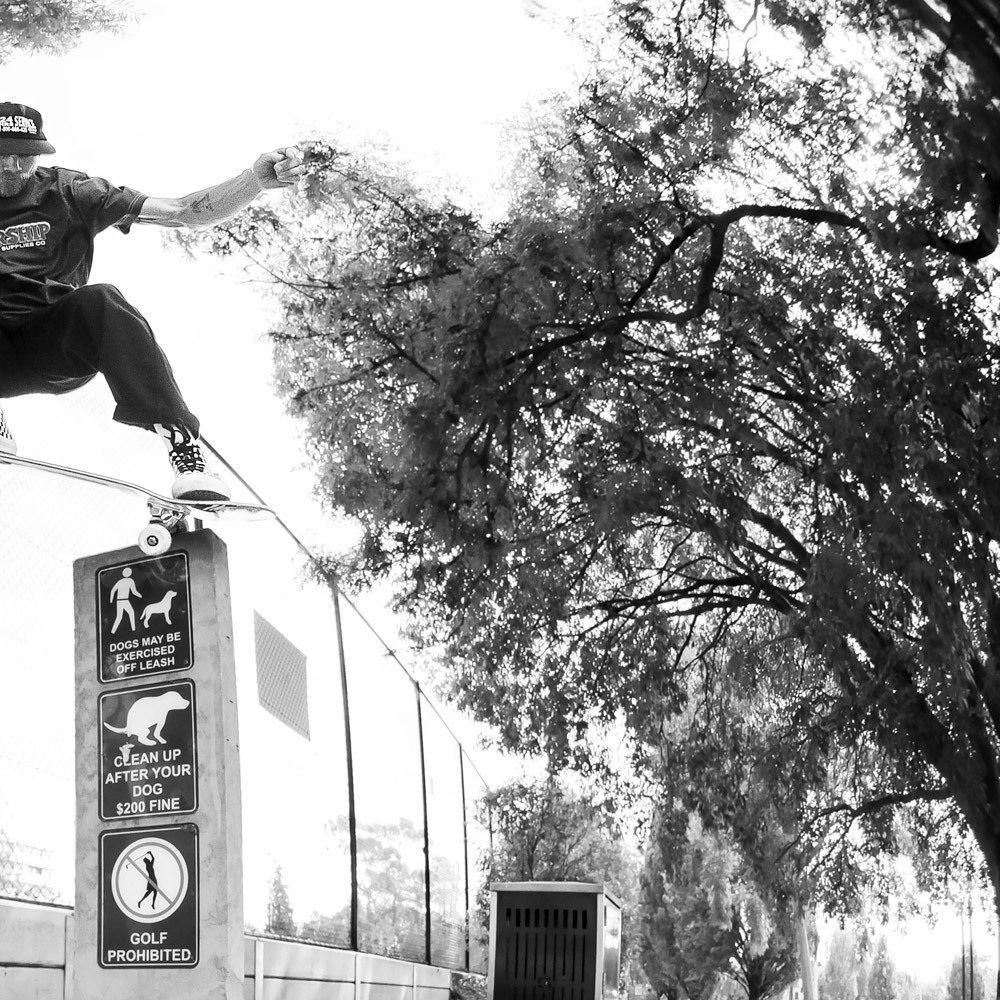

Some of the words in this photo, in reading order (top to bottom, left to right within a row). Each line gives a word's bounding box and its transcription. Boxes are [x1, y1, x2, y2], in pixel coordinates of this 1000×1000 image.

[1, 242, 34, 251] SUPPLIES
[109, 639, 139, 652] DOGS
[141, 634, 164, 646] MAY
[166, 632, 181, 642] BE
[116, 645, 175, 662] EXERCISED
[116, 662, 137, 674] OFF
[139, 657, 175, 670] LEASH
[114, 751, 158, 767] CLEAN
[163, 749, 181, 761] UP
[105, 769, 149, 784] AFTER
[152, 764, 191, 779] YOUR
[132, 783, 163, 797] DOG
[116, 801, 145, 815] $200
[149, 797, 180, 812] FINE
[130, 931, 168, 945] GOLF
[107, 949, 191, 962] PROHIBITED
